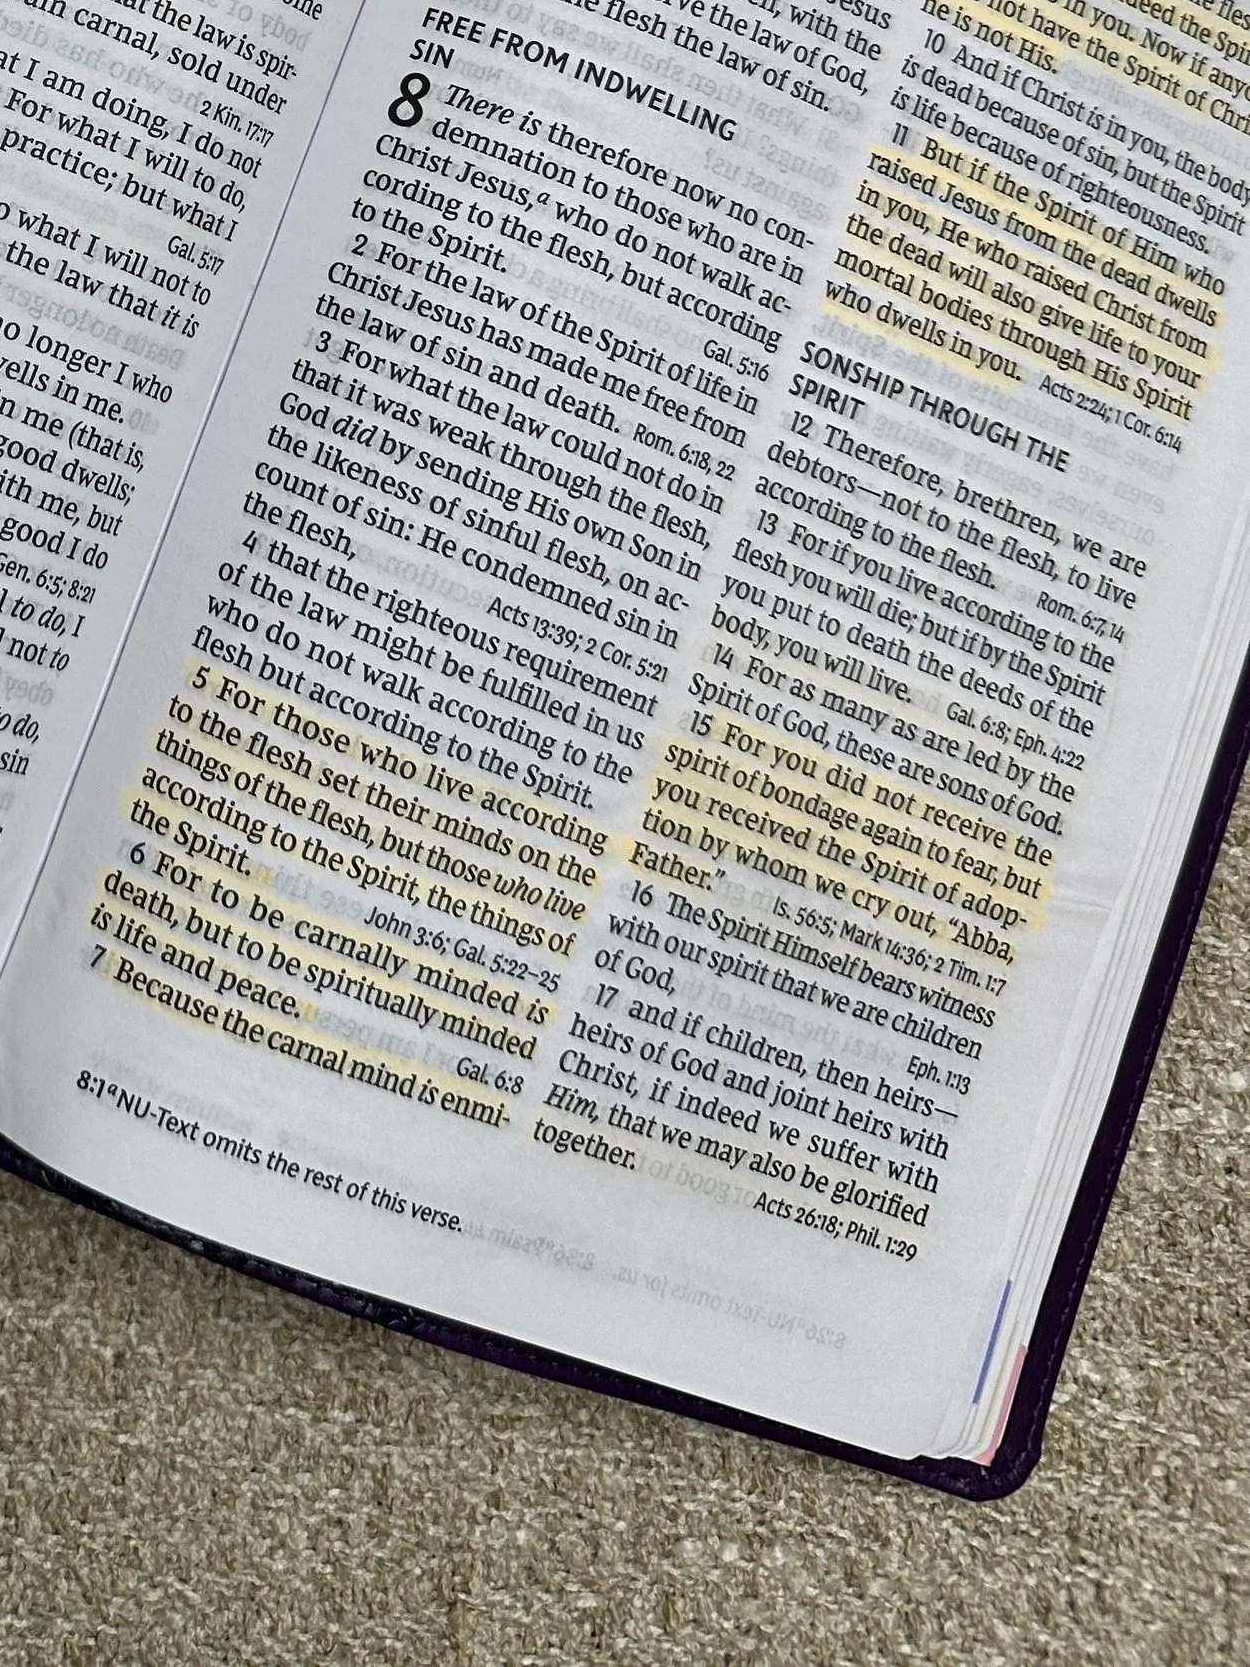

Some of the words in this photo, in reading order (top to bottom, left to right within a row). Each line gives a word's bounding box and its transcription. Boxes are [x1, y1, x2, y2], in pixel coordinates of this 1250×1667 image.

[409, 39, 455, 69] SIN
[422, 7, 486, 44] FREE
[489, 28, 570, 74] FROM
[574, 58, 737, 141] INDWELLING
[388, 72, 431, 128] 8
[444, 84, 515, 124] There
[518, 111, 543, 136] is
[548, 122, 667, 187] therefore
[670, 175, 726, 210] now
[725, 200, 758, 226] no
[764, 217, 814, 249] con-
[704, 340, 733, 368] Gal.
[736, 356, 769, 382] 5:16
[788, 373, 866, 420] SPIRIT
[799, 341, 905, 399] SONSHIP
[909, 385, 1021, 451] THROUGH
[1026, 435, 1070, 473] THE
[790, 410, 813, 438] 12
[823, 424, 944, 498] Therefore,
[953, 479, 1061, 546] brethren,
[1073, 532, 1103, 560] we
[1109, 550, 1146, 578] are
[652, 777, 700, 810] you
[705, 797, 812, 851] received
[816, 835, 856, 868] the
[860, 851, 928, 894] Spirit
[933, 882, 961, 905] of
[961, 892, 1027, 931] adop-
[90, 944, 107, 968] 7
[113, 956, 219, 1025] Because
[222, 1008, 264, 1043] the
[267, 1031, 348, 1077] carnal
[347, 1059, 417, 1099] mind
[417, 1078, 439, 1105] is
[440, 1092, 510, 1128] enmi-
[456, 1057, 489, 1086] Gal.
[494, 1070, 524, 1095] 6:8
[568, 1012, 634, 1054] heirs
[640, 1041, 668, 1065] of
[671, 1048, 719, 1083] God
[722, 1069, 770, 1099] and
[769, 1080, 830, 1119] joint
[832, 1099, 893, 1140] heirs
[900, 1126, 949, 1160] with
[203, 1132, 262, 1165] omits
[266, 1150, 300, 1178] the
[303, 1167, 343, 1194] rest
[346, 1182, 370, 1201] of
[371, 1187, 407, 1214] this
[412, 1202, 462, 1232] verse.
[753, 1191, 793, 1219] Acts
[794, 1207, 844, 1239] 26:18;
[845, 1221, 880, 1249] Phil.
[885, 1236, 917, 1262] 1:29
